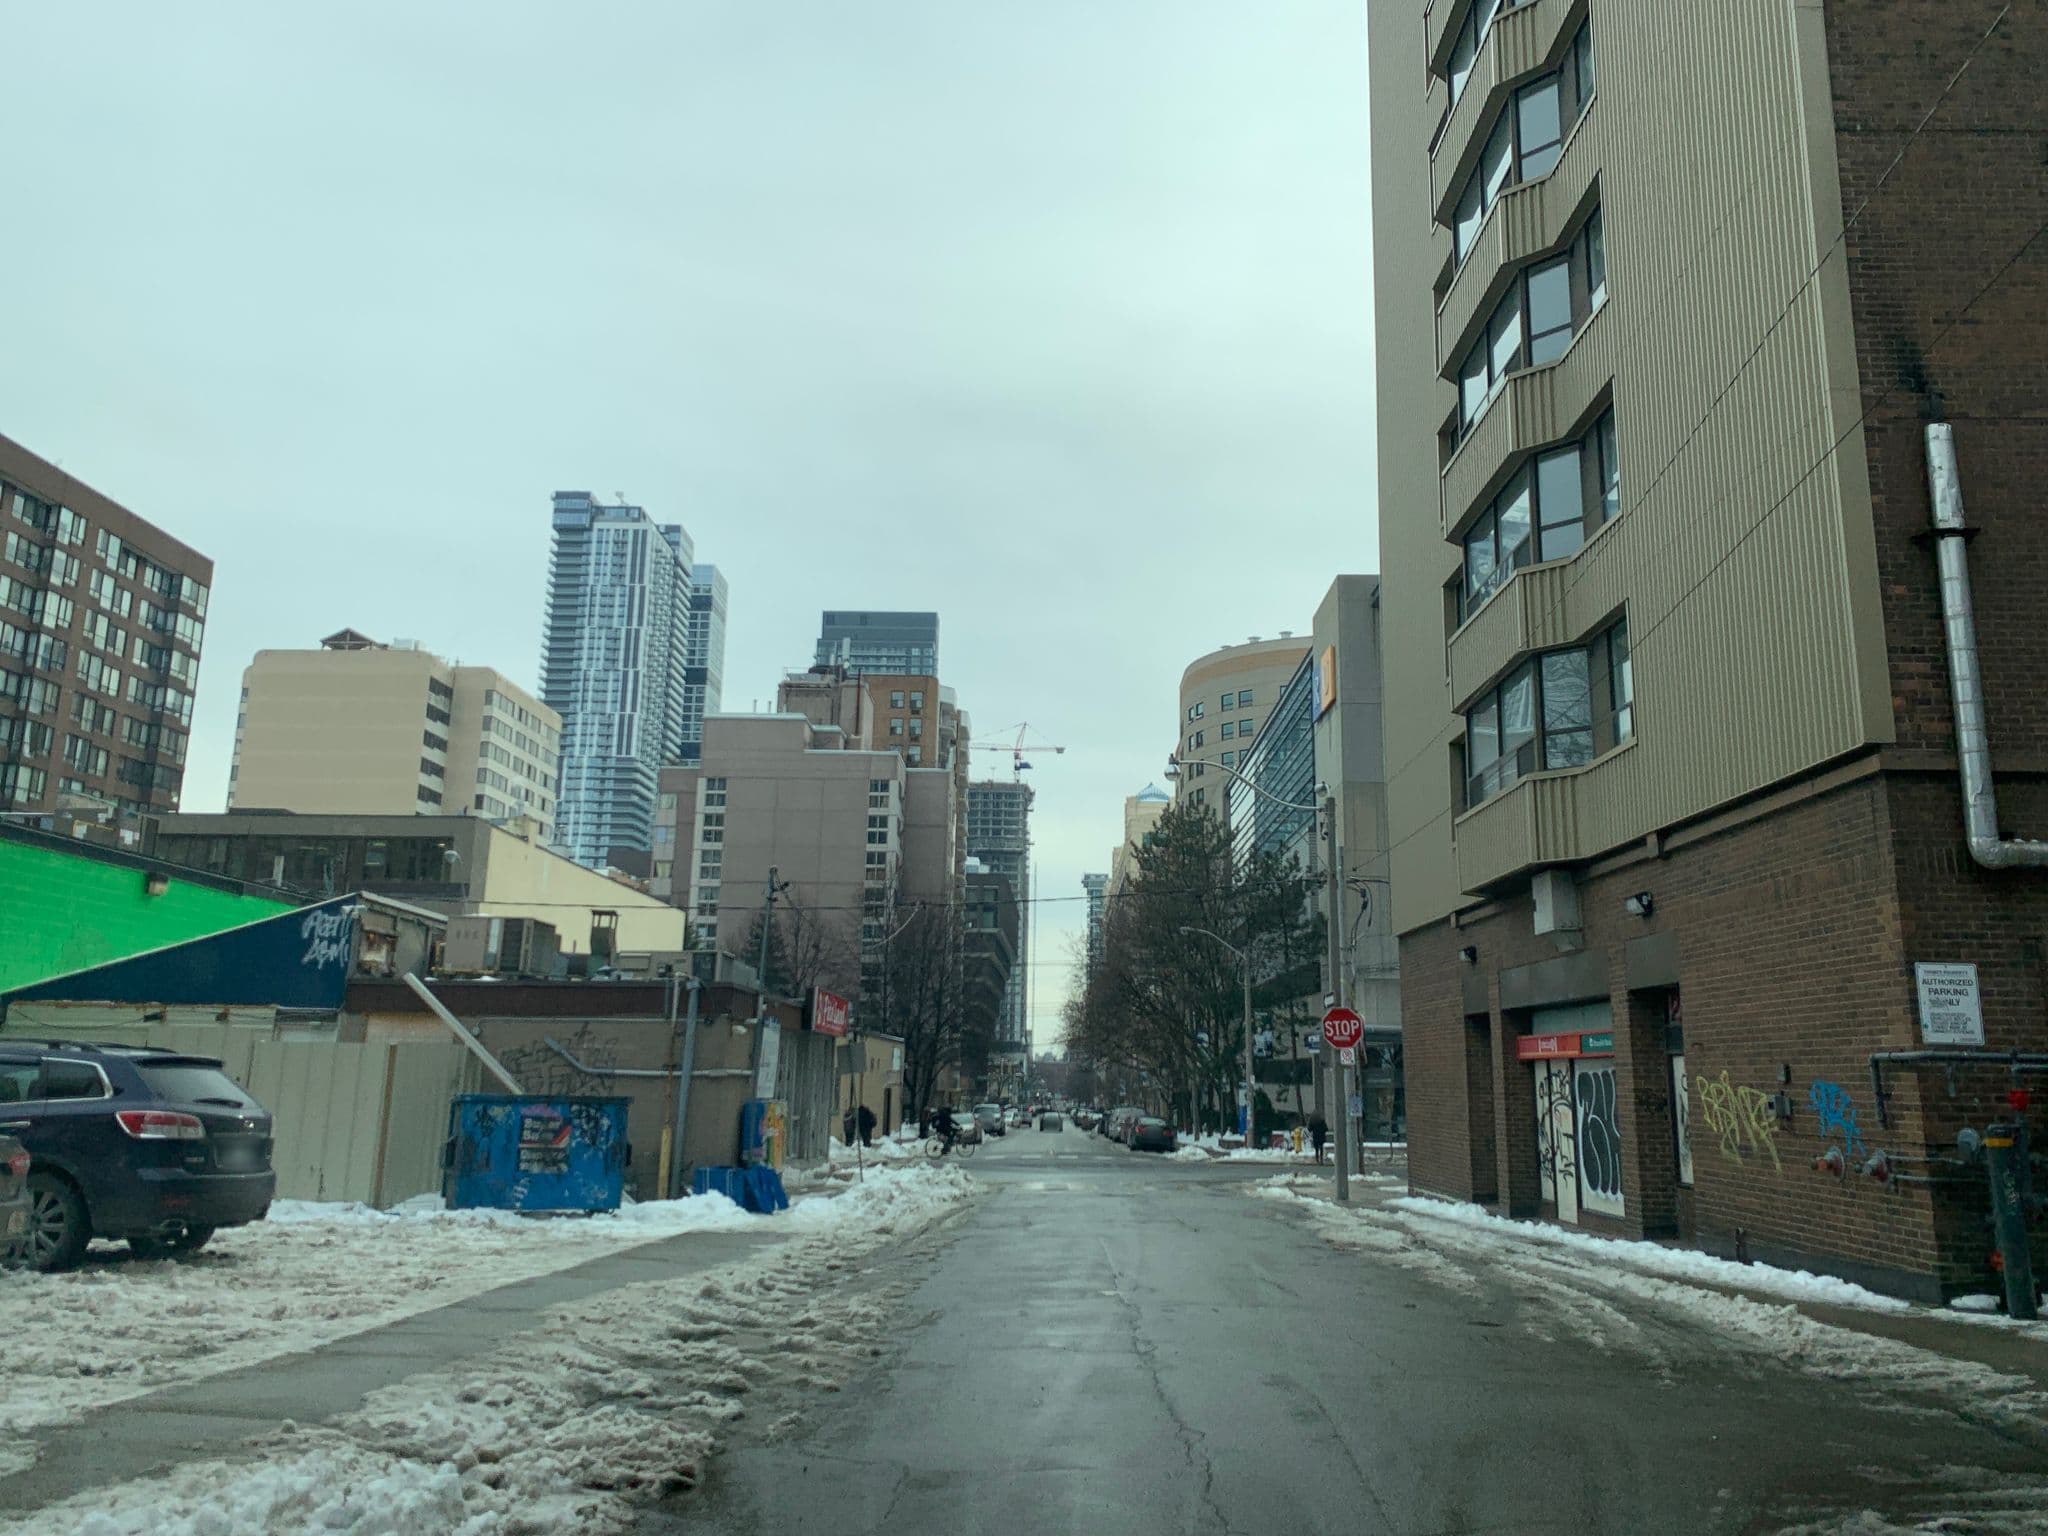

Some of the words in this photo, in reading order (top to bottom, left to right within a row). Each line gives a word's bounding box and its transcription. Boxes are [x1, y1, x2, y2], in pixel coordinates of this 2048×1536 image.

[1922, 978, 1974, 986] AUTHORIZED
[1928, 988, 1969, 996] PARKING
[1325, 1020, 1359, 1037] STOP
